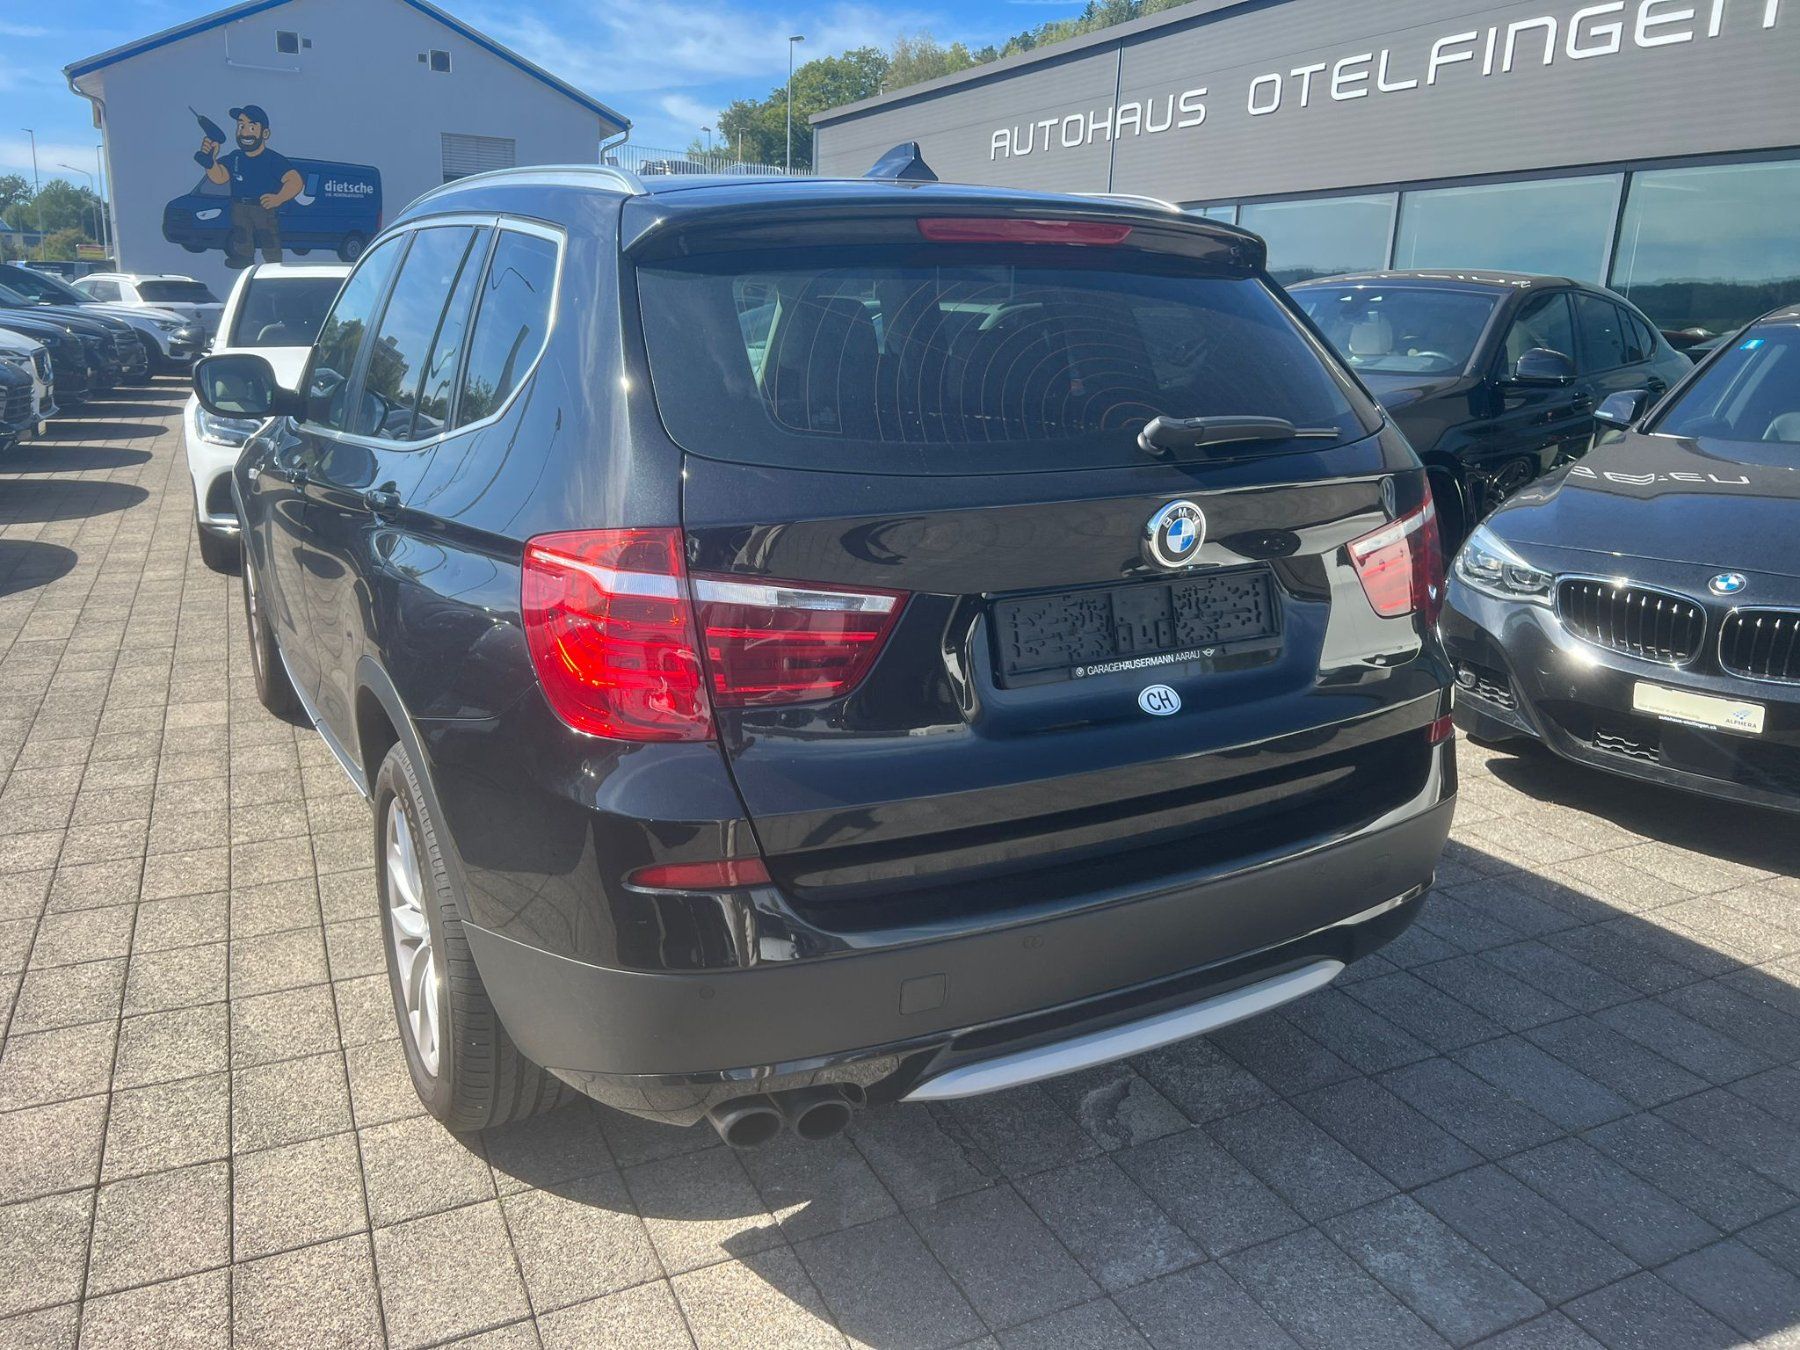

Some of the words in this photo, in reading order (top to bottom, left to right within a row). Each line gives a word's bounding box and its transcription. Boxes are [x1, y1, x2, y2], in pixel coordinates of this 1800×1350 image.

[991, 87, 1208, 161] AUTOHAUS
[324, 180, 374, 194] dietsche
[1161, 507, 1201, 529] BMW
[1174, 649, 1200, 662] AARAU
[1146, 690, 1175, 711] CH
